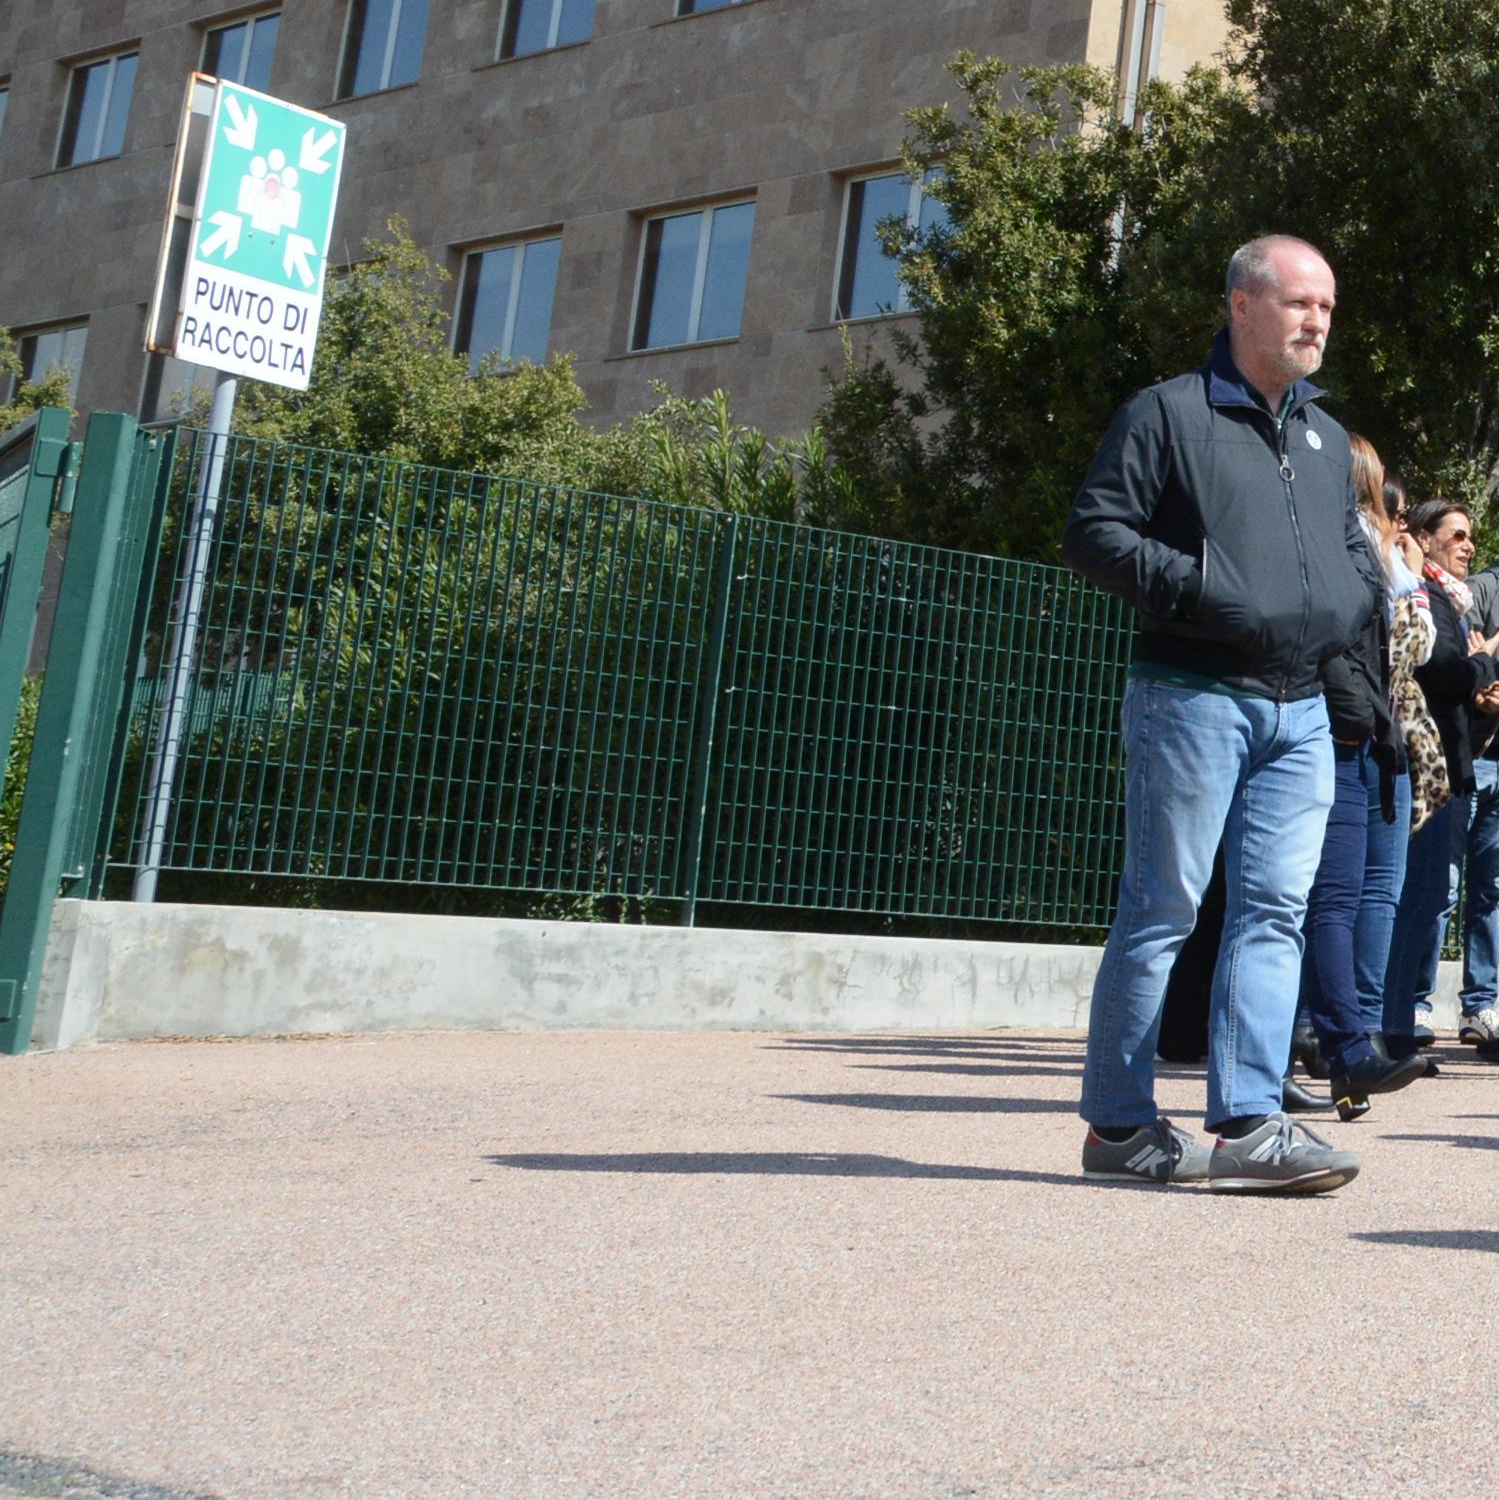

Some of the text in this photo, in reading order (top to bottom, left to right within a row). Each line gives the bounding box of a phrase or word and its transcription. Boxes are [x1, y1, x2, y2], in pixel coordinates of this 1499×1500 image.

[195, 277, 308, 335] PUNTO DI
[182, 315, 306, 376] RACCOLTA
